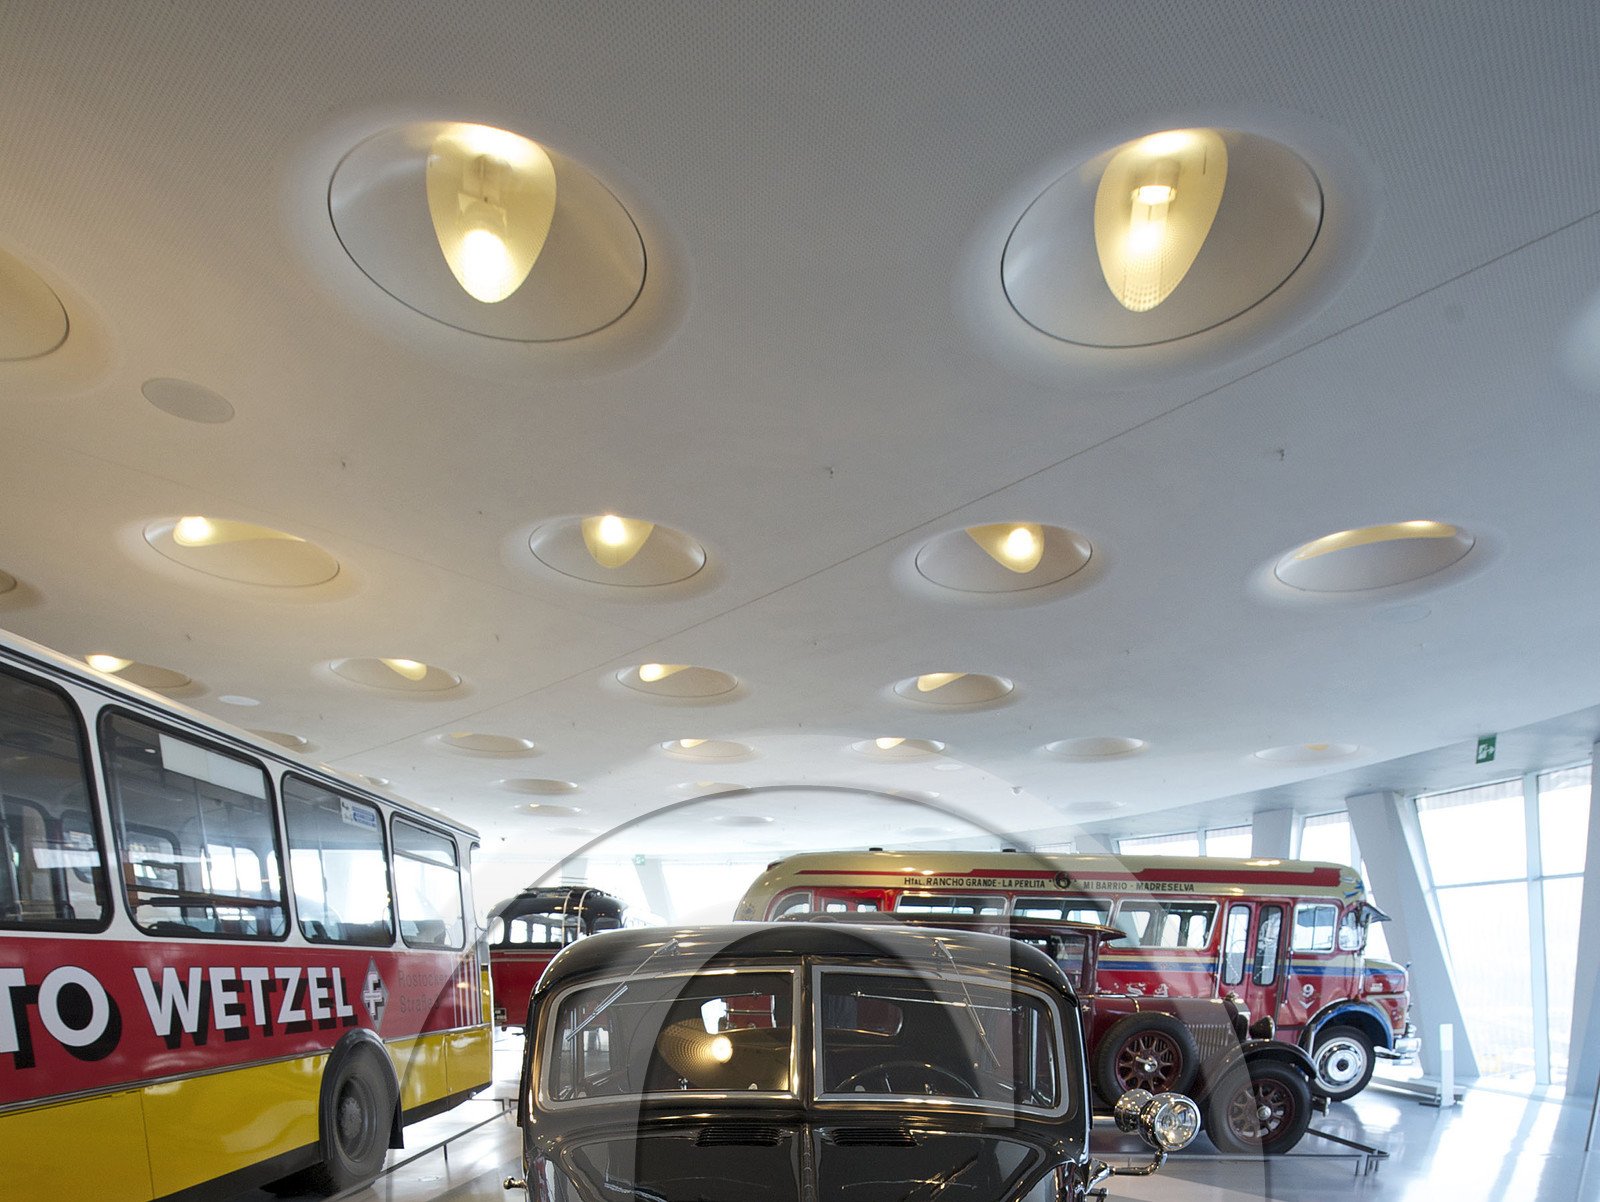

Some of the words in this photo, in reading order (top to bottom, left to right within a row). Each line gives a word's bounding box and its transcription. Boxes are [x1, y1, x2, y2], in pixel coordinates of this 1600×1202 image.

[926, 877, 964, 887] RANCHO
[966, 878, 996, 888] GRANDE
[1002, 879, 1012, 888] LA
[1014, 879, 1045, 888] PERLITA
[1083, 881, 1094, 890] MI
[1095, 881, 1127, 890] BARRIO
[1136, 882, 1195, 892] MADRESELVA
[1302, 983, 1315, 998] 9
[132, 966, 354, 1037] WETZEL
